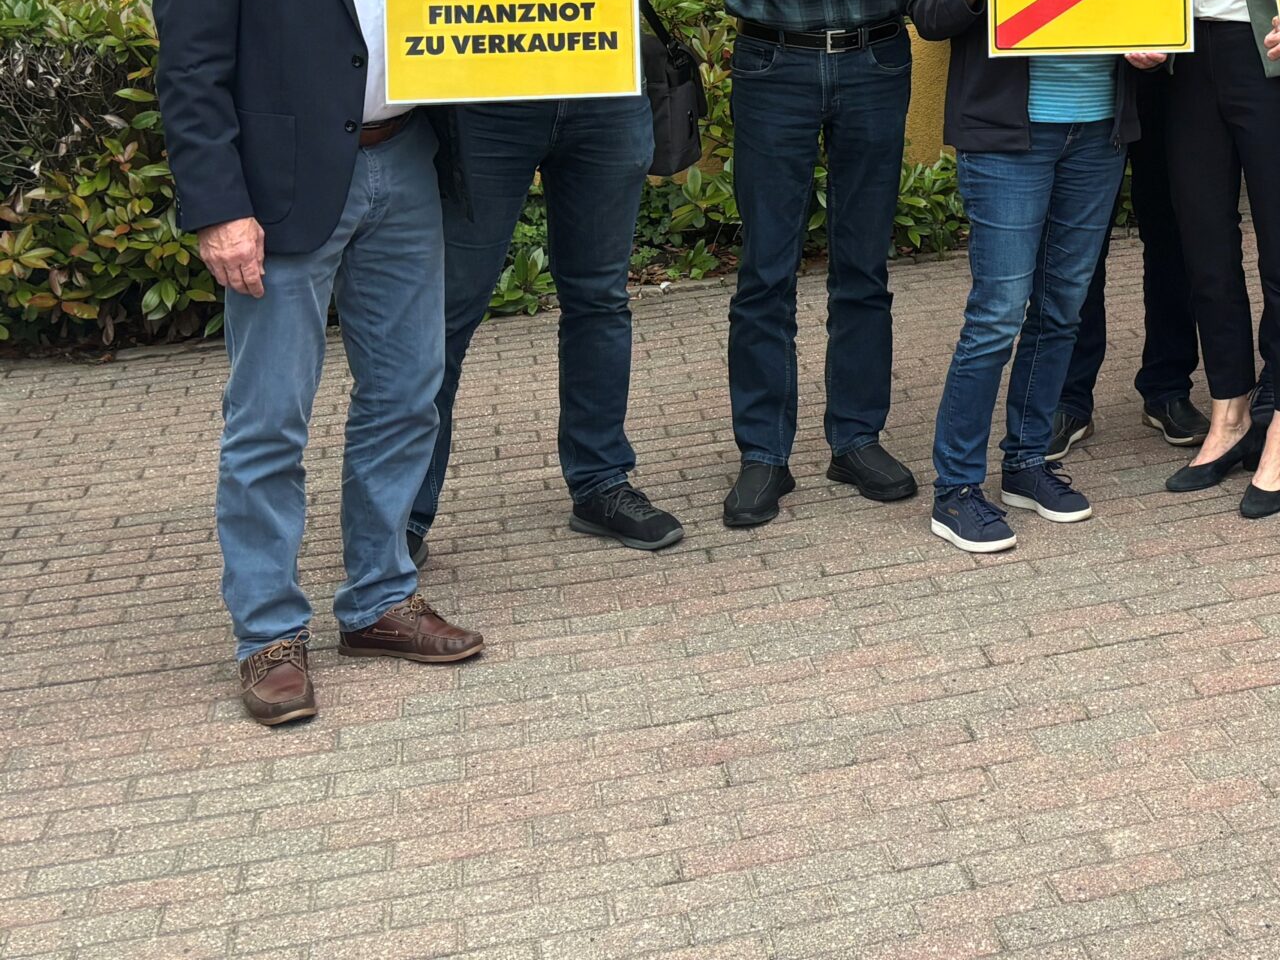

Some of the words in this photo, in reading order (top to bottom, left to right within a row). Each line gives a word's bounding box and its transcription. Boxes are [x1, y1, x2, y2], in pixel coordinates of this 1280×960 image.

[429, 2, 596, 25] FINANZNOT
[405, 35, 445, 56] ZU
[451, 31, 618, 54] VERKAUFEN
